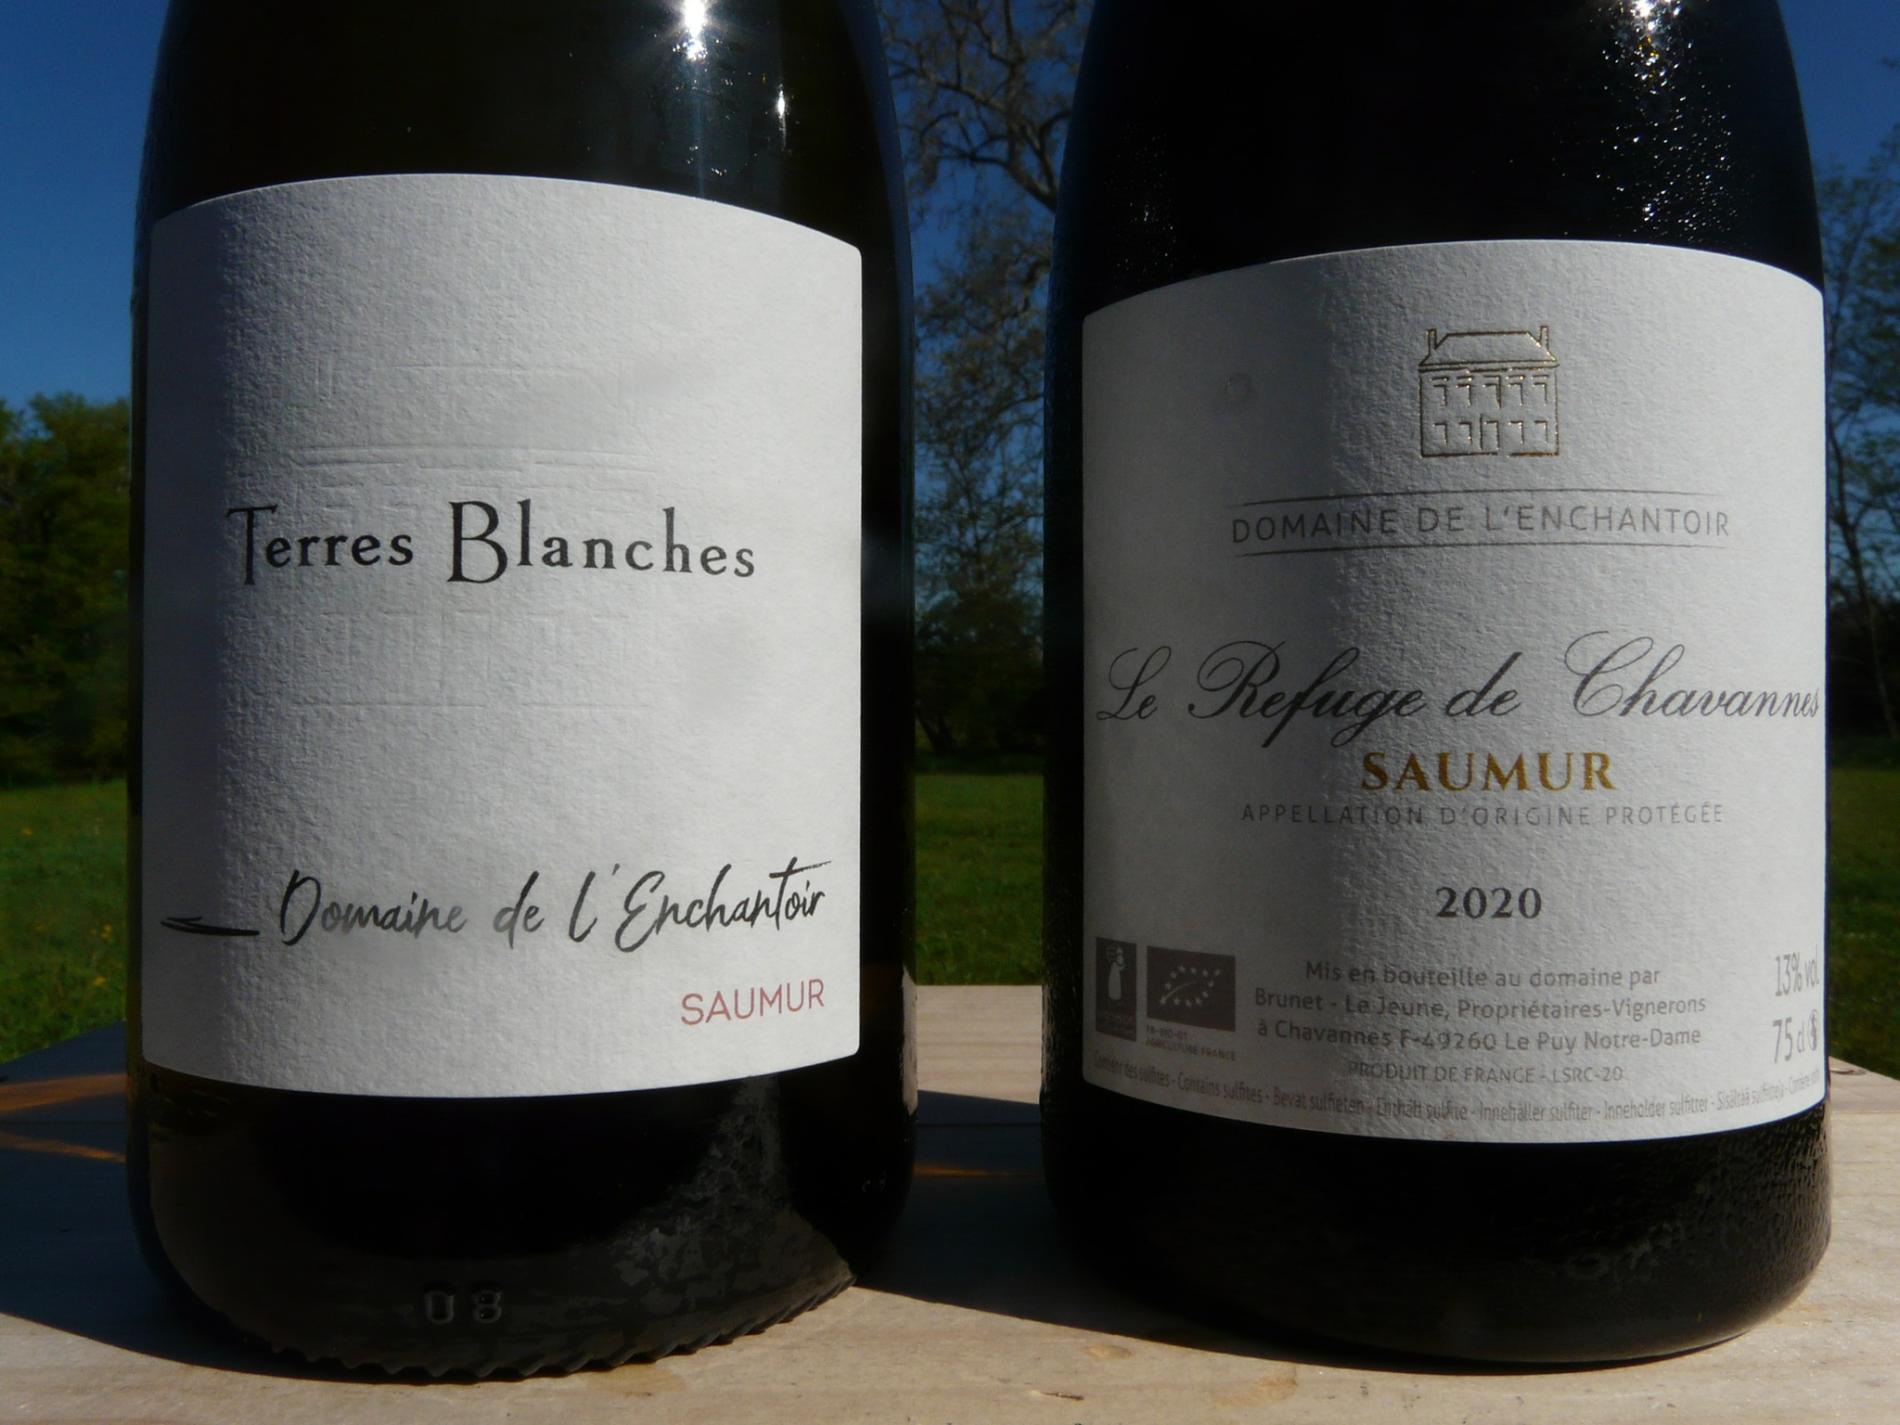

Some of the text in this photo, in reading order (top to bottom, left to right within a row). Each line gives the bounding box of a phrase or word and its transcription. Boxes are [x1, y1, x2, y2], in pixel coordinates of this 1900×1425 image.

[225, 499, 756, 586] Terres Blanches
[1232, 504, 1731, 544] DOMAINE DE L'ENCHANTOIR
[1095, 630, 1820, 750] Le Refuge de Chavannes
[1361, 750, 1617, 793] SAUMUR
[1241, 799, 1725, 827] APPELLATION D'ORIGINE PROTÉGÉE
[279, 868, 469, 947] Domaine
[493, 870, 544, 951] de
[1436, 887, 1542, 919] 2020
[1305, 960, 1661, 994] Mis en bouteille au domaine par
[1775, 952, 1801, 997] 13%
[680, 978, 826, 1026] SAUMUR
[1255, 986, 1324, 1012] Brunet
[1345, 1000, 1373, 1015] Le
[1374, 999, 1450, 1020] Jeune,
[1457, 997, 1707, 1023] Propriétaires-Vignerons
[1257, 1019, 1702, 1056] à Chavannes F-49260 Le Puy Notre-Dame
[1772, 1016, 1794, 1063] 75
[1349, 1059, 1428, 1081] PRODUIT
[1434, 1065, 1458, 1082] DE
[1464, 1066, 1535, 1084] FRANCE
